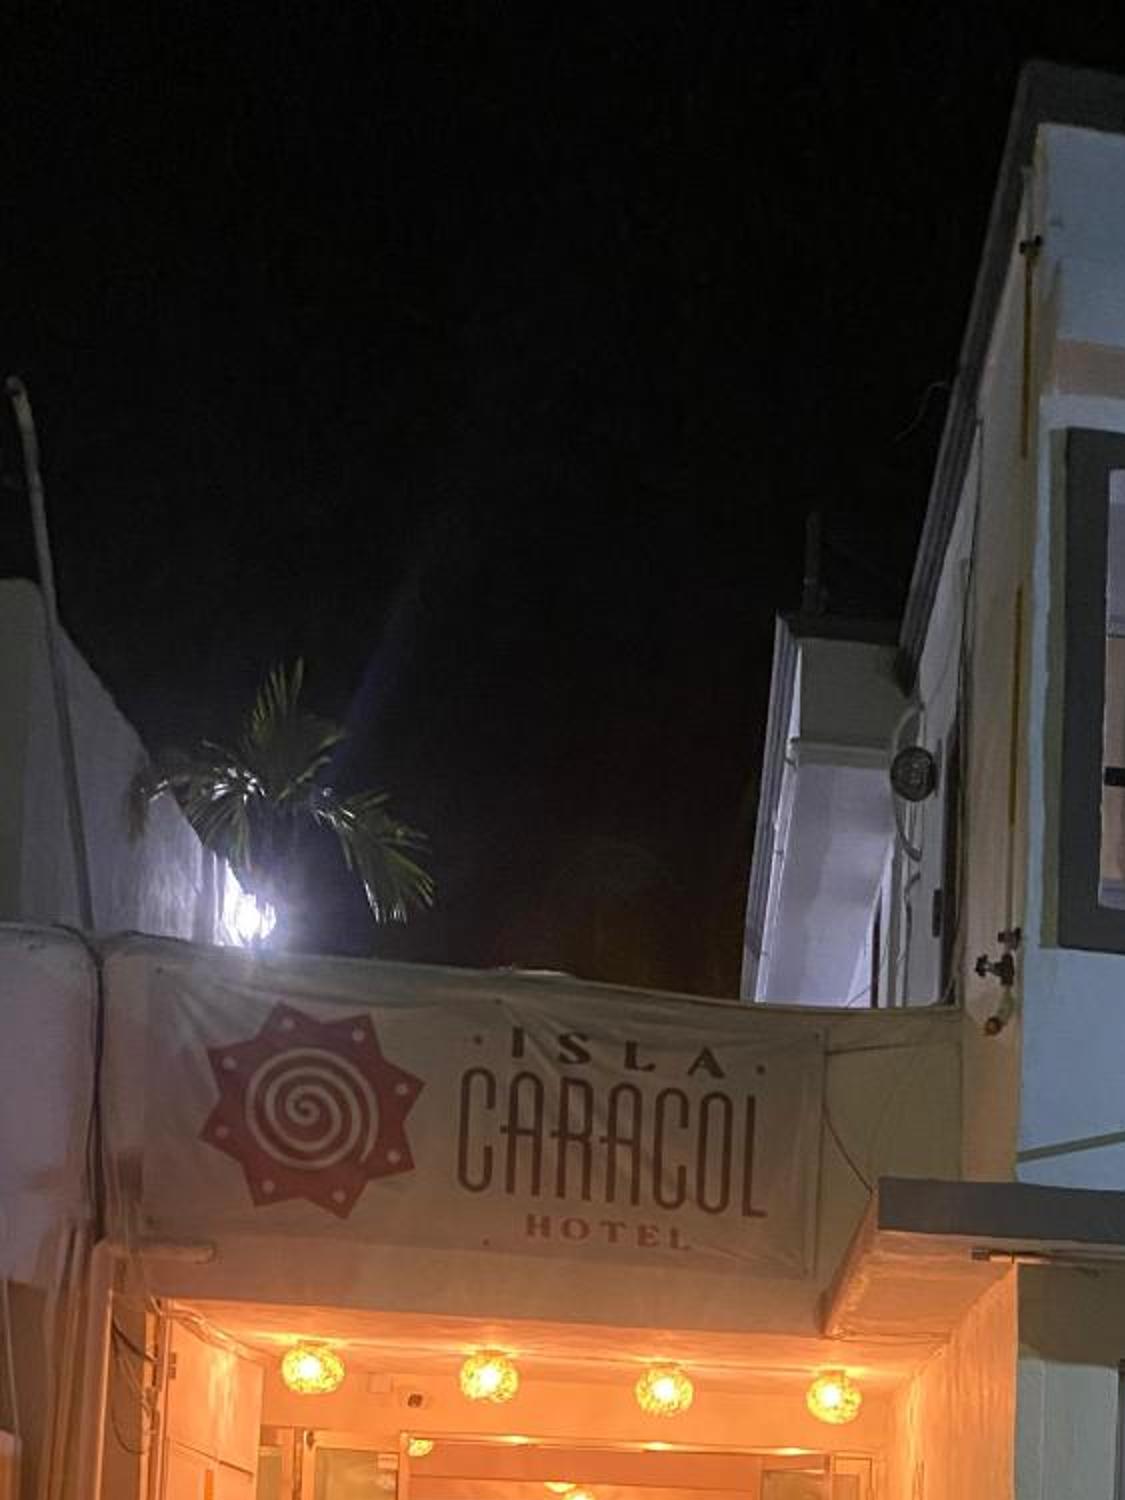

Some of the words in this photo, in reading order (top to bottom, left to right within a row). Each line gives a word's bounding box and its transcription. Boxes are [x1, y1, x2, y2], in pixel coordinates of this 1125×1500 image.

[511, 1026, 726, 1079] ISLA
[457, 1066, 768, 1218] CARACOL
[525, 1213, 690, 1250] HOTEL
